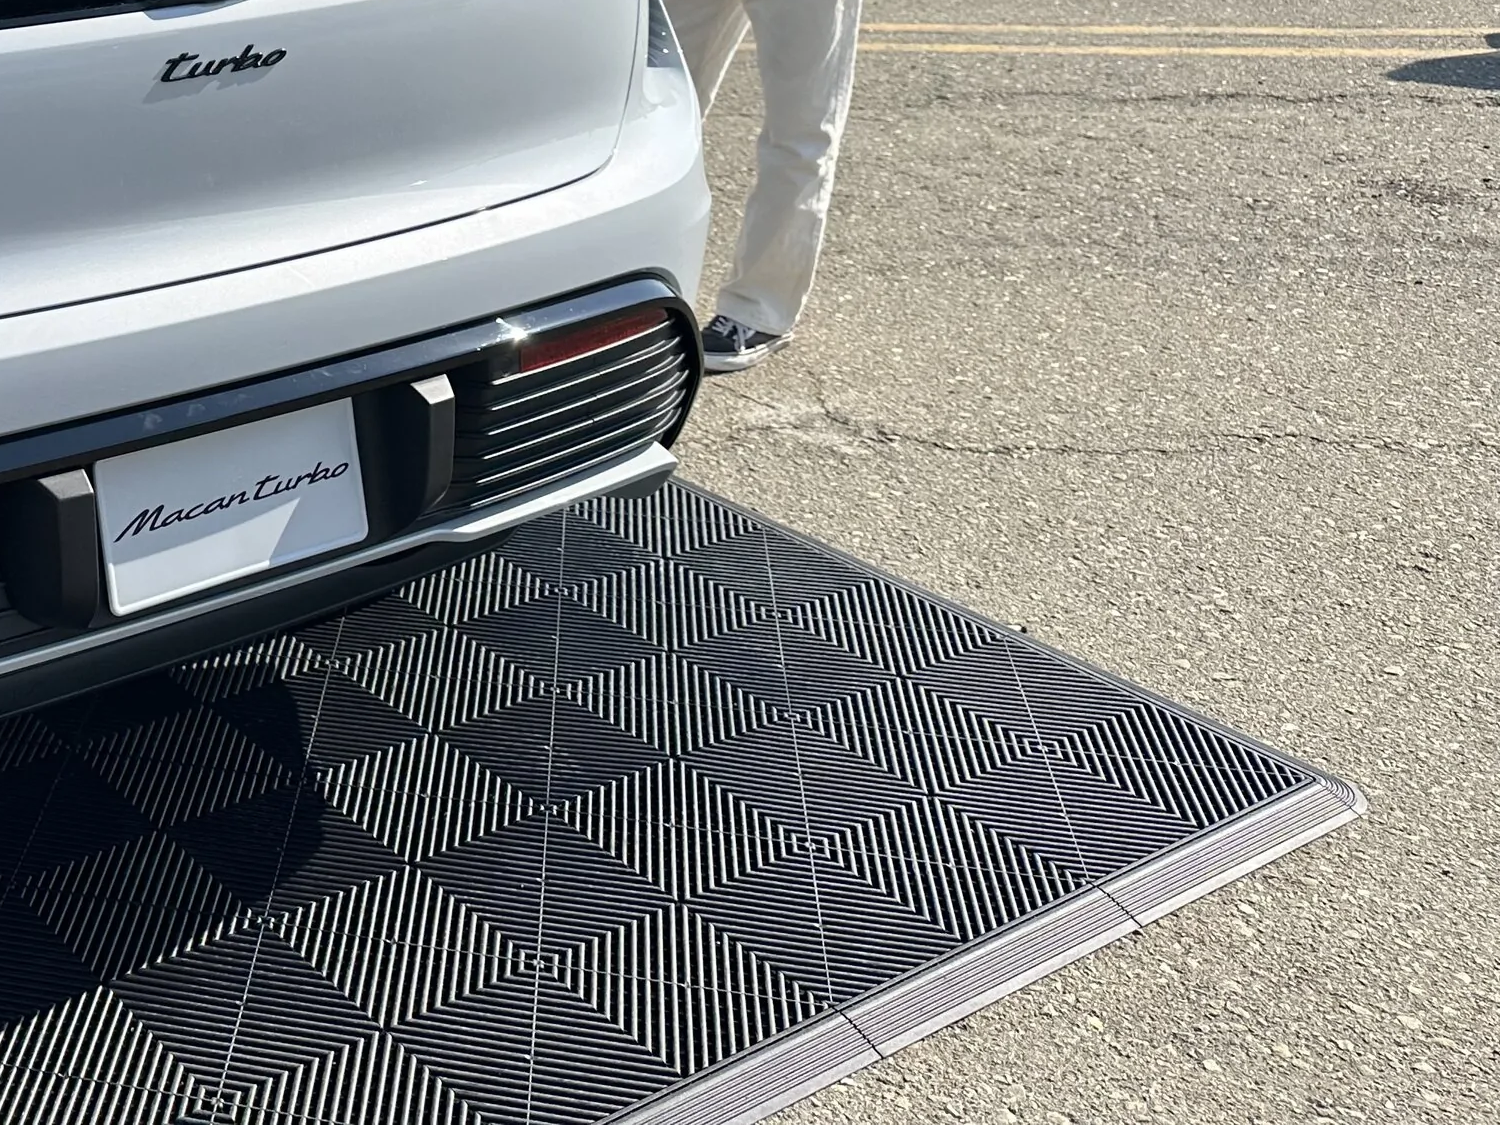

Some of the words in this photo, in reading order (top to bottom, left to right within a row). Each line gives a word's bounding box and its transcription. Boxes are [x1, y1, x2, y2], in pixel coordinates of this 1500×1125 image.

[161, 43, 287, 83] turbo
[113, 490, 250, 543] Macan
[252, 461, 349, 501] turbo
